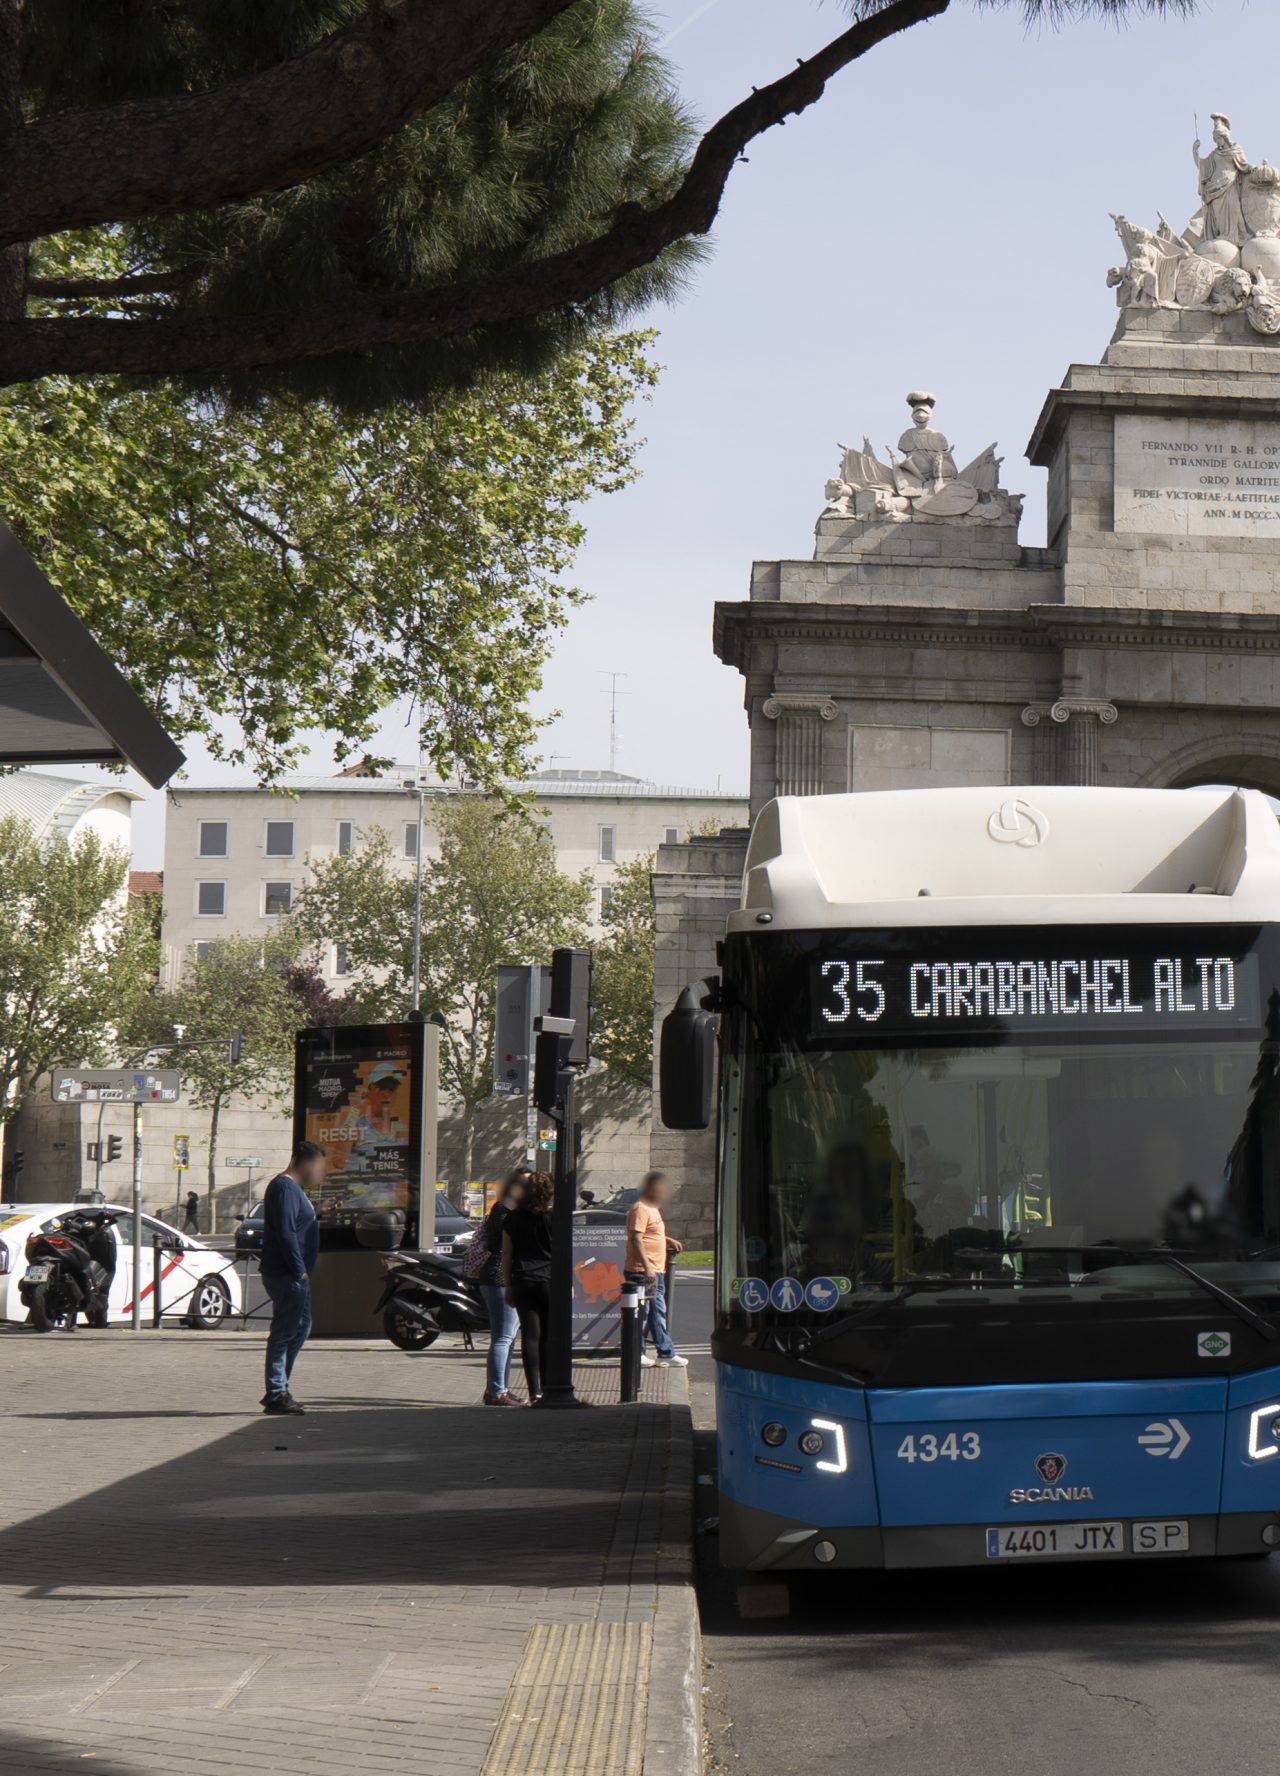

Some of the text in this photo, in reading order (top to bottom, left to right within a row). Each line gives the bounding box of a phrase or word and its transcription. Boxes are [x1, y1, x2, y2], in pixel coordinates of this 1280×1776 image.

[1142, 441, 1198, 452] FERNANDO
[1205, 445, 1223, 453] VII
[1168, 457, 1227, 468] TYRANNIDE
[1199, 476, 1229, 485] ORDO
[821, 957, 1235, 1022] 35 CARABANCHEL ALTO
[841, 1280, 847, 1289] 3
[1204, 1340, 1224, 1348] GNC
[897, 1432, 981, 1463] 4343
[1009, 1486, 1094, 1503] SCANIA
[1005, 1529, 1057, 1553] 4401
[1074, 1526, 1116, 1550] JTX
